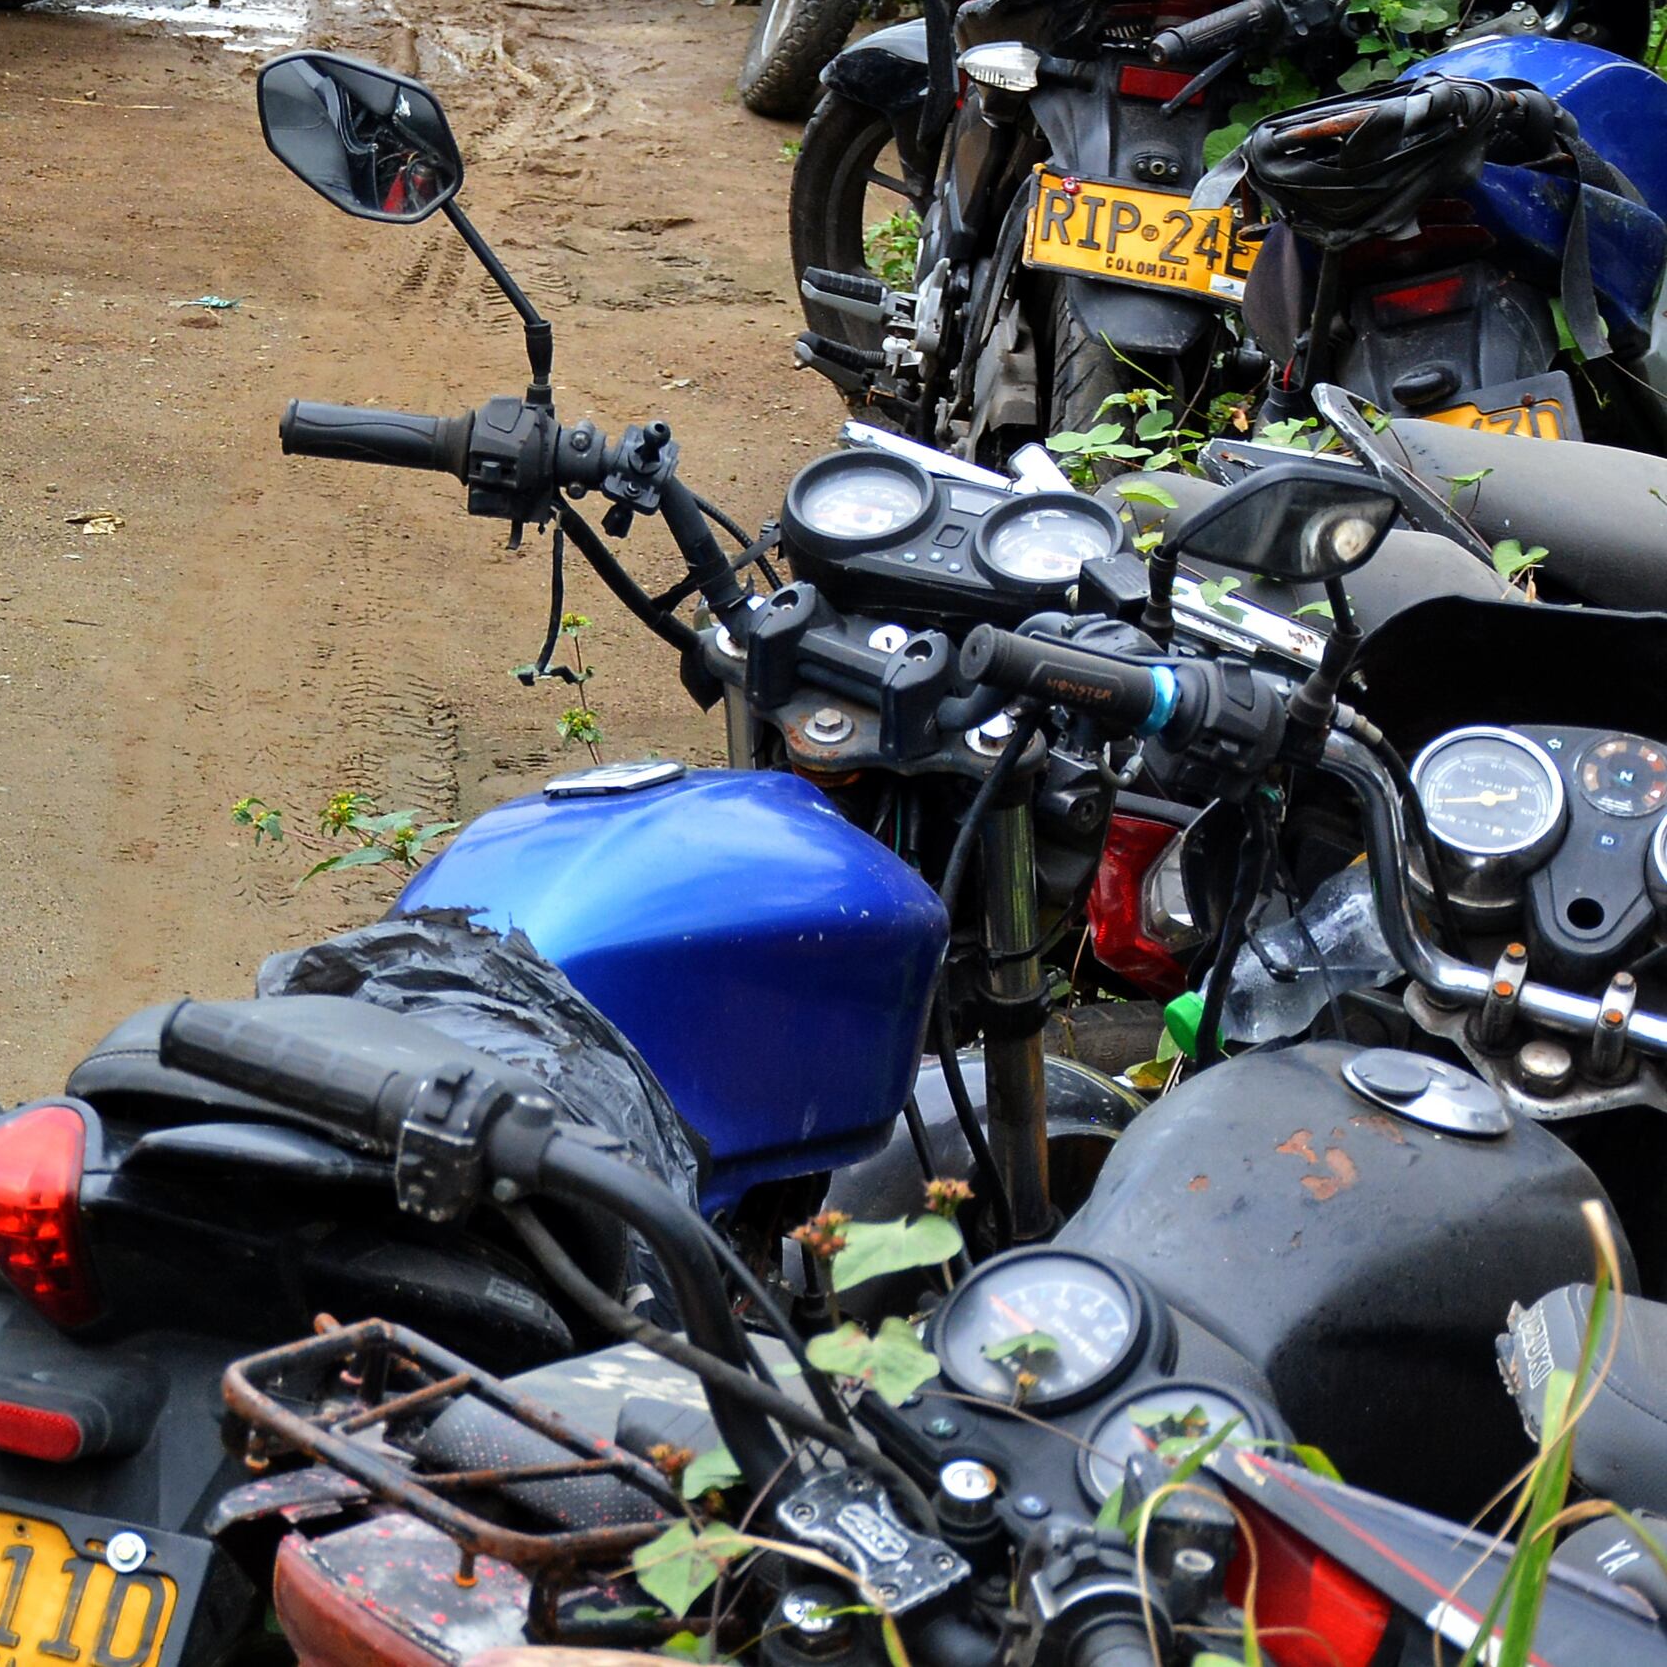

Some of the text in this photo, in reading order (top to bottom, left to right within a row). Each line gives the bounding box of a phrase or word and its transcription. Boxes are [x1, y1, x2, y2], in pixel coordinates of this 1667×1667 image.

[1040, 189, 1142, 254] RIP
[1104, 256, 1189, 282] COLOMBIA
[1046, 677, 1113, 701] MONSTER
